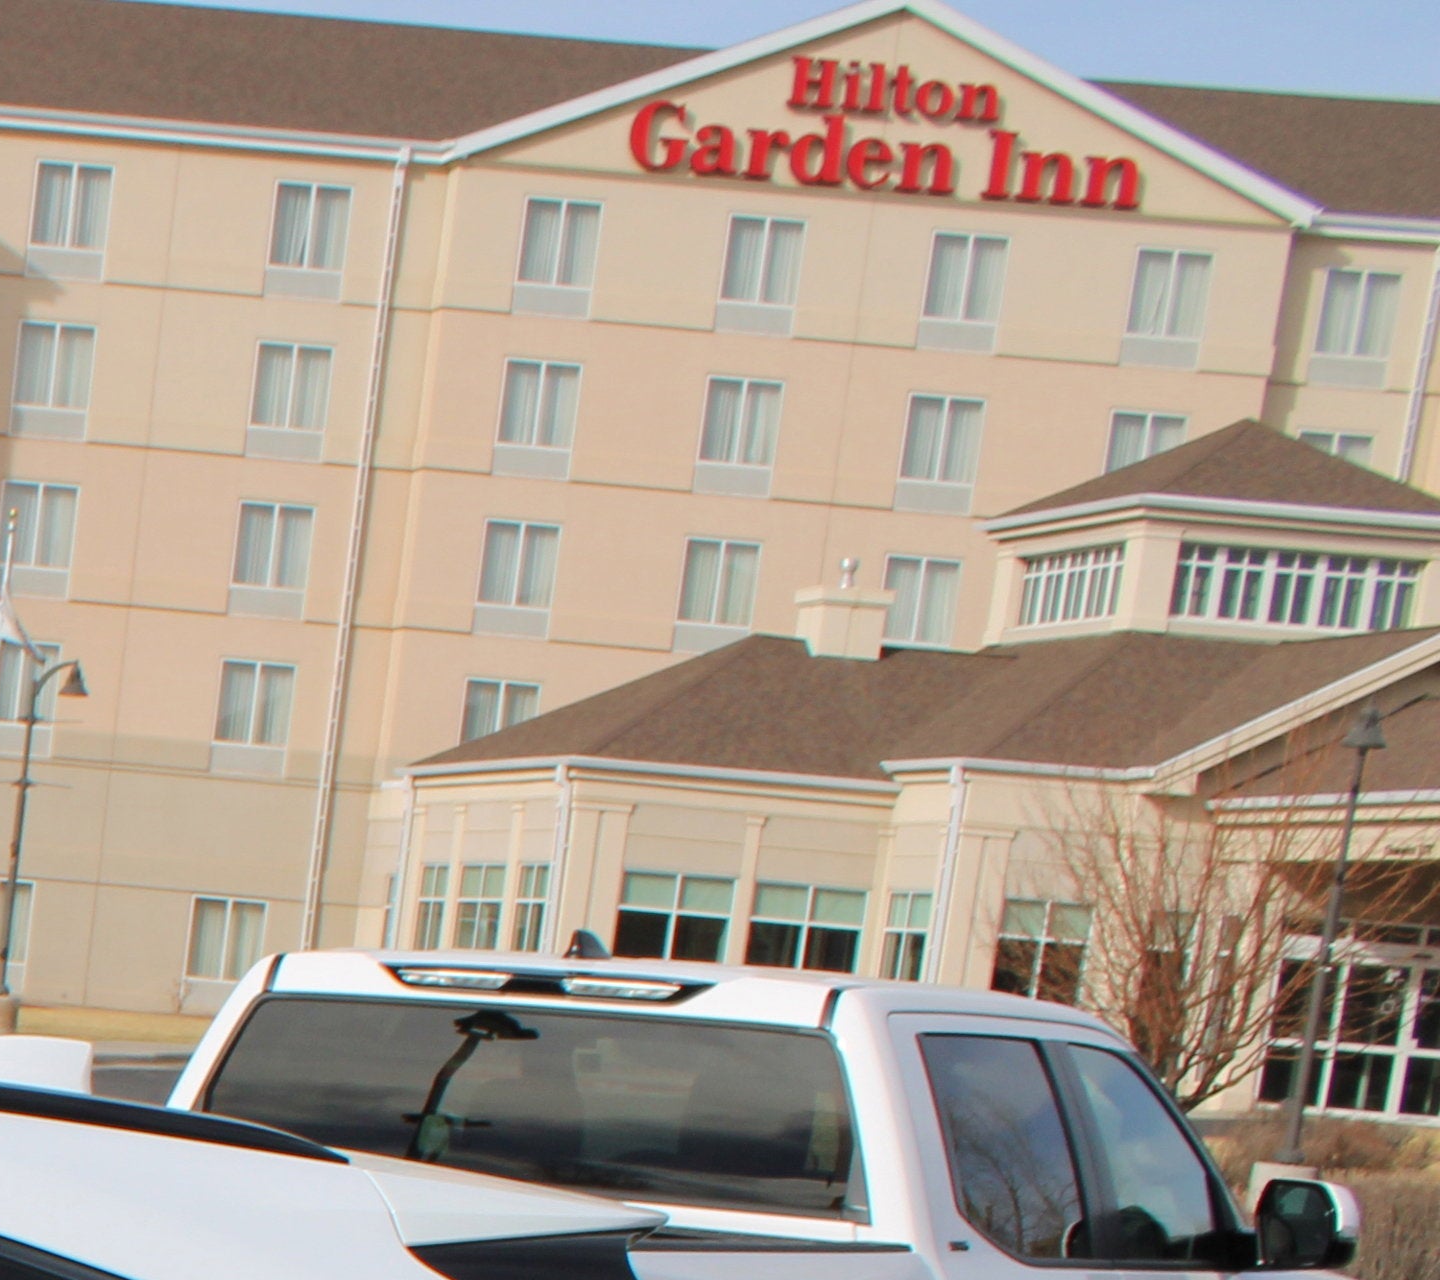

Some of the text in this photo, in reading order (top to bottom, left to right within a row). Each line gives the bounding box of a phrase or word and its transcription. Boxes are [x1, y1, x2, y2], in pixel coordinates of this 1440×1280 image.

[786, 56, 1000, 122] Hilton
[628, 101, 1141, 211] Garden Inn
